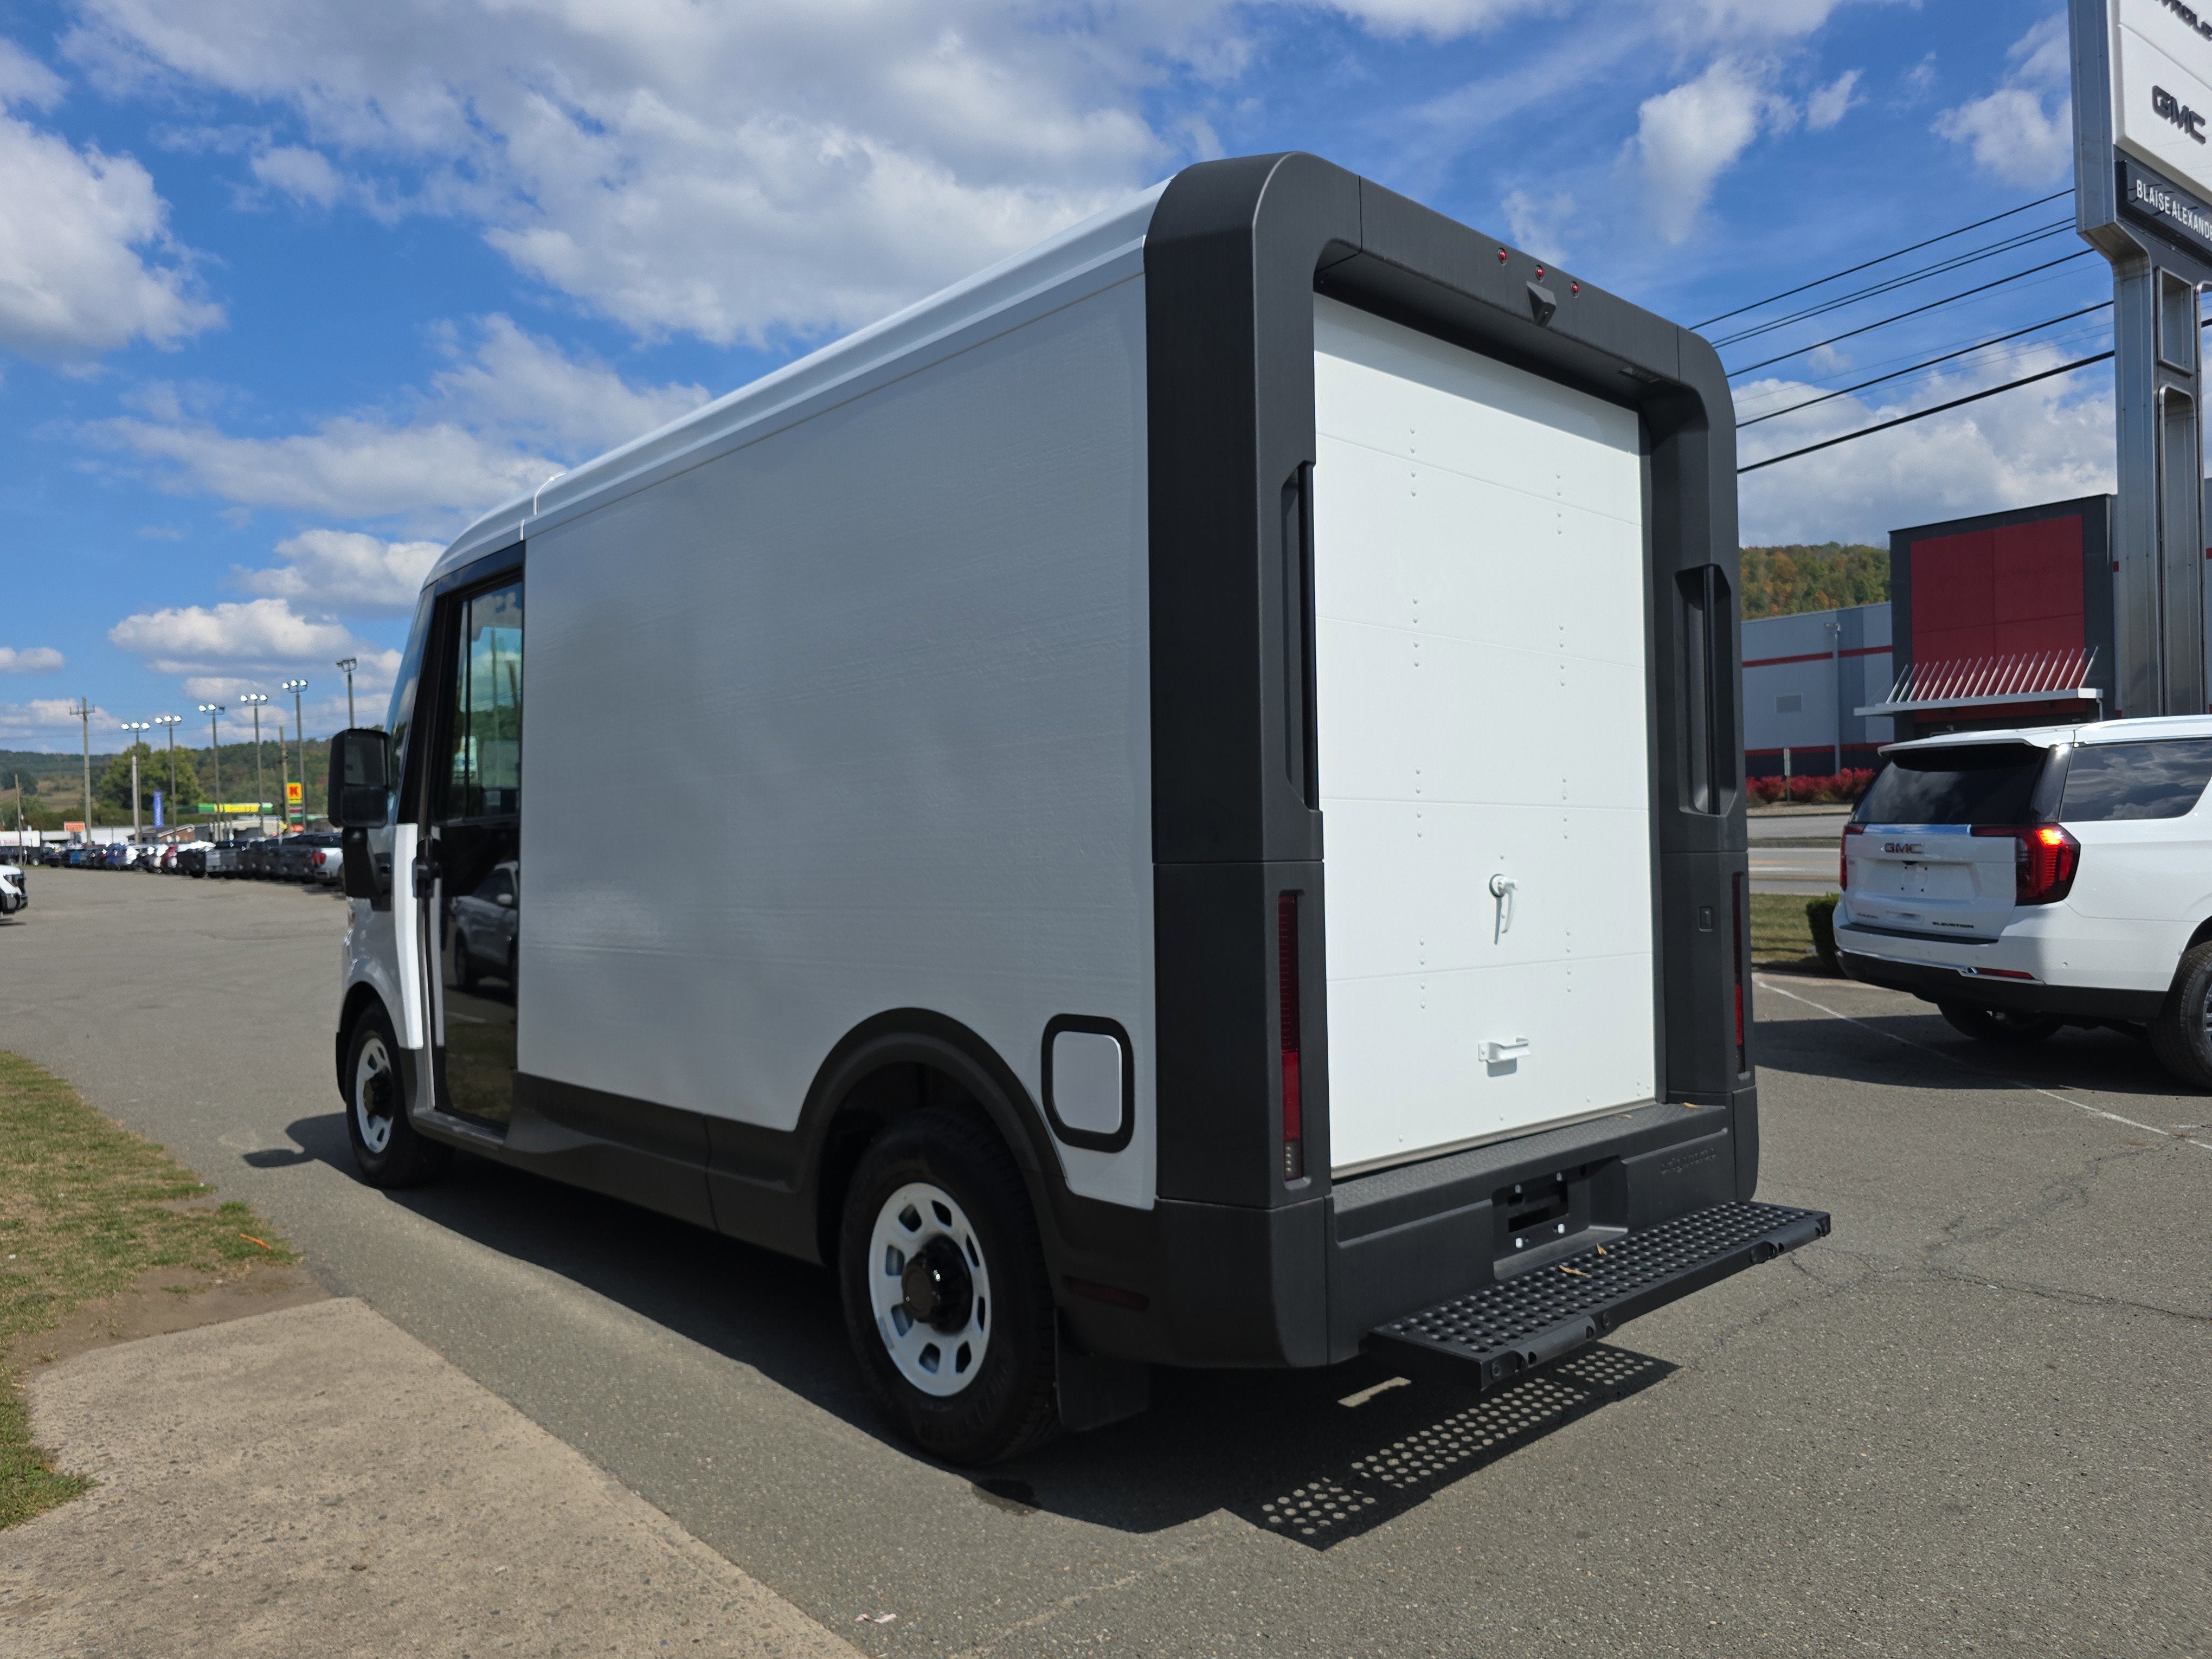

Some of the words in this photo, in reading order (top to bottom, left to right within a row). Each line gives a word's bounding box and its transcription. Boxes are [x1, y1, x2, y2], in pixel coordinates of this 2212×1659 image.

[2152, 85, 2205, 145] GMC
[2137, 179, 2170, 215] BLAISE
[1884, 842, 1924, 854] GMC
